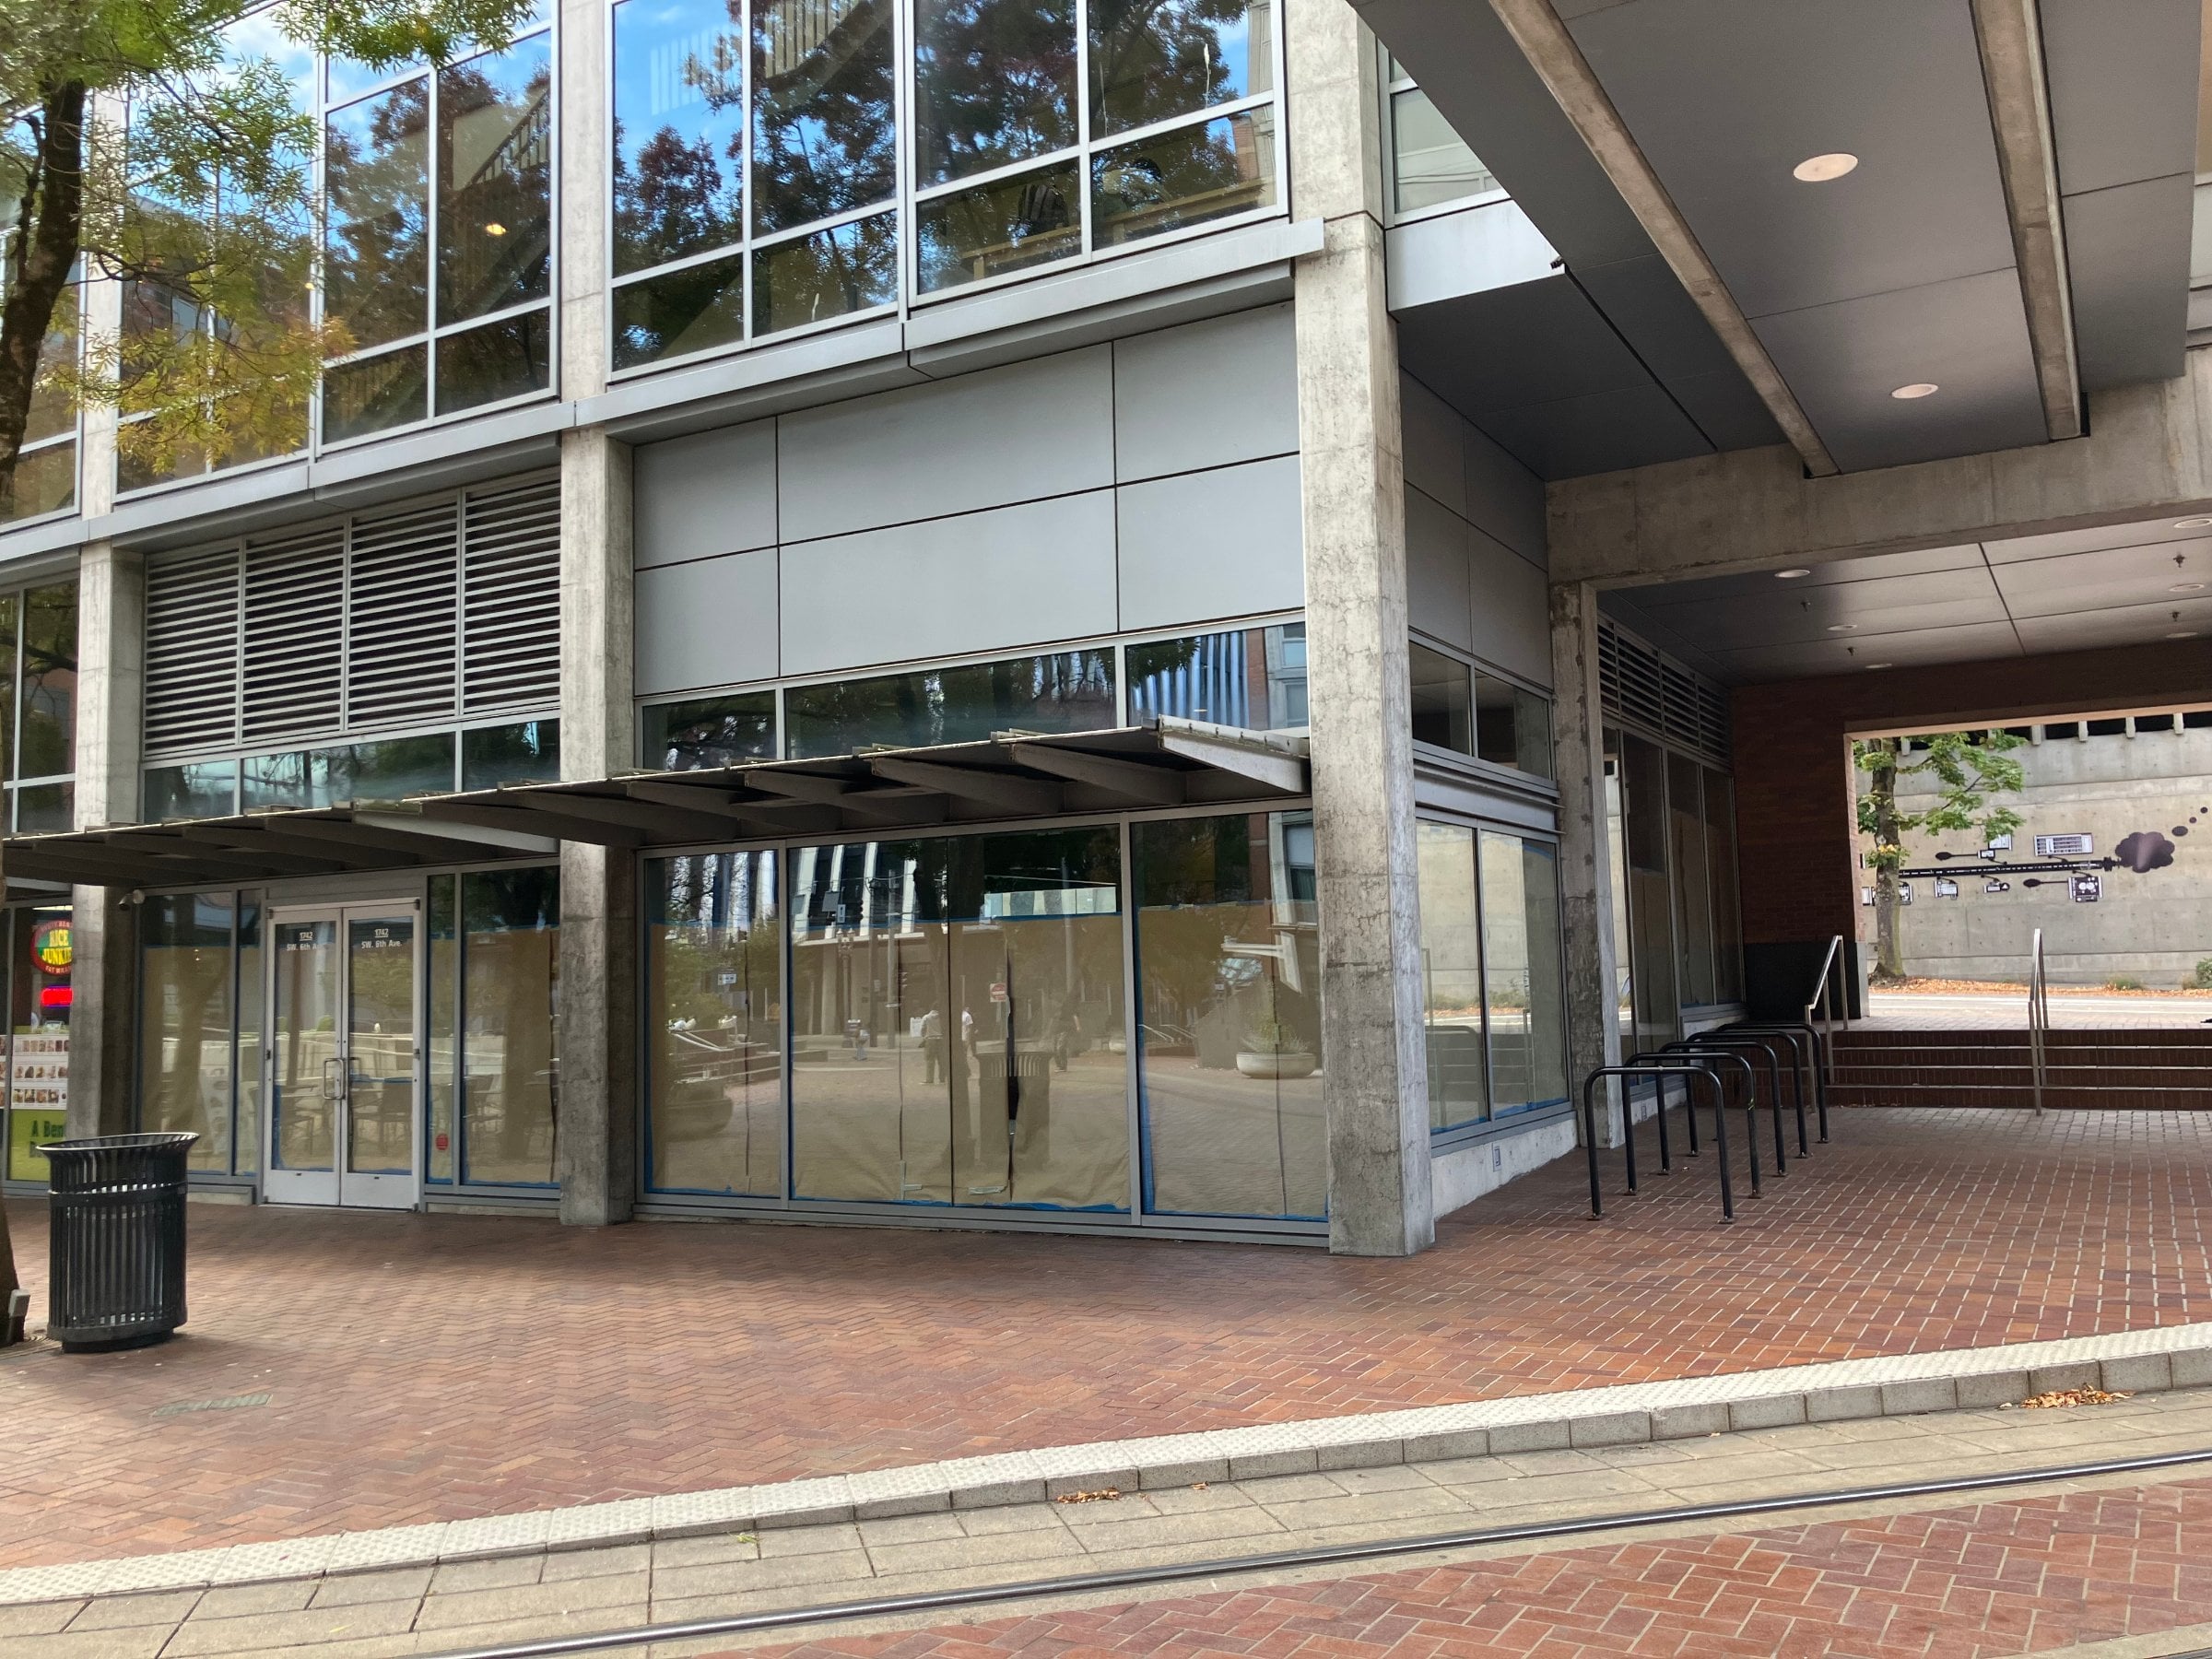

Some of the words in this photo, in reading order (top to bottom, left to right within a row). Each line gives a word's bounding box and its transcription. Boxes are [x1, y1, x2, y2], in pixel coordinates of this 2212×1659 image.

[49, 929, 69, 947] RICE
[375, 928, 389, 936] 1742
[32, 1120, 39, 1136] A
